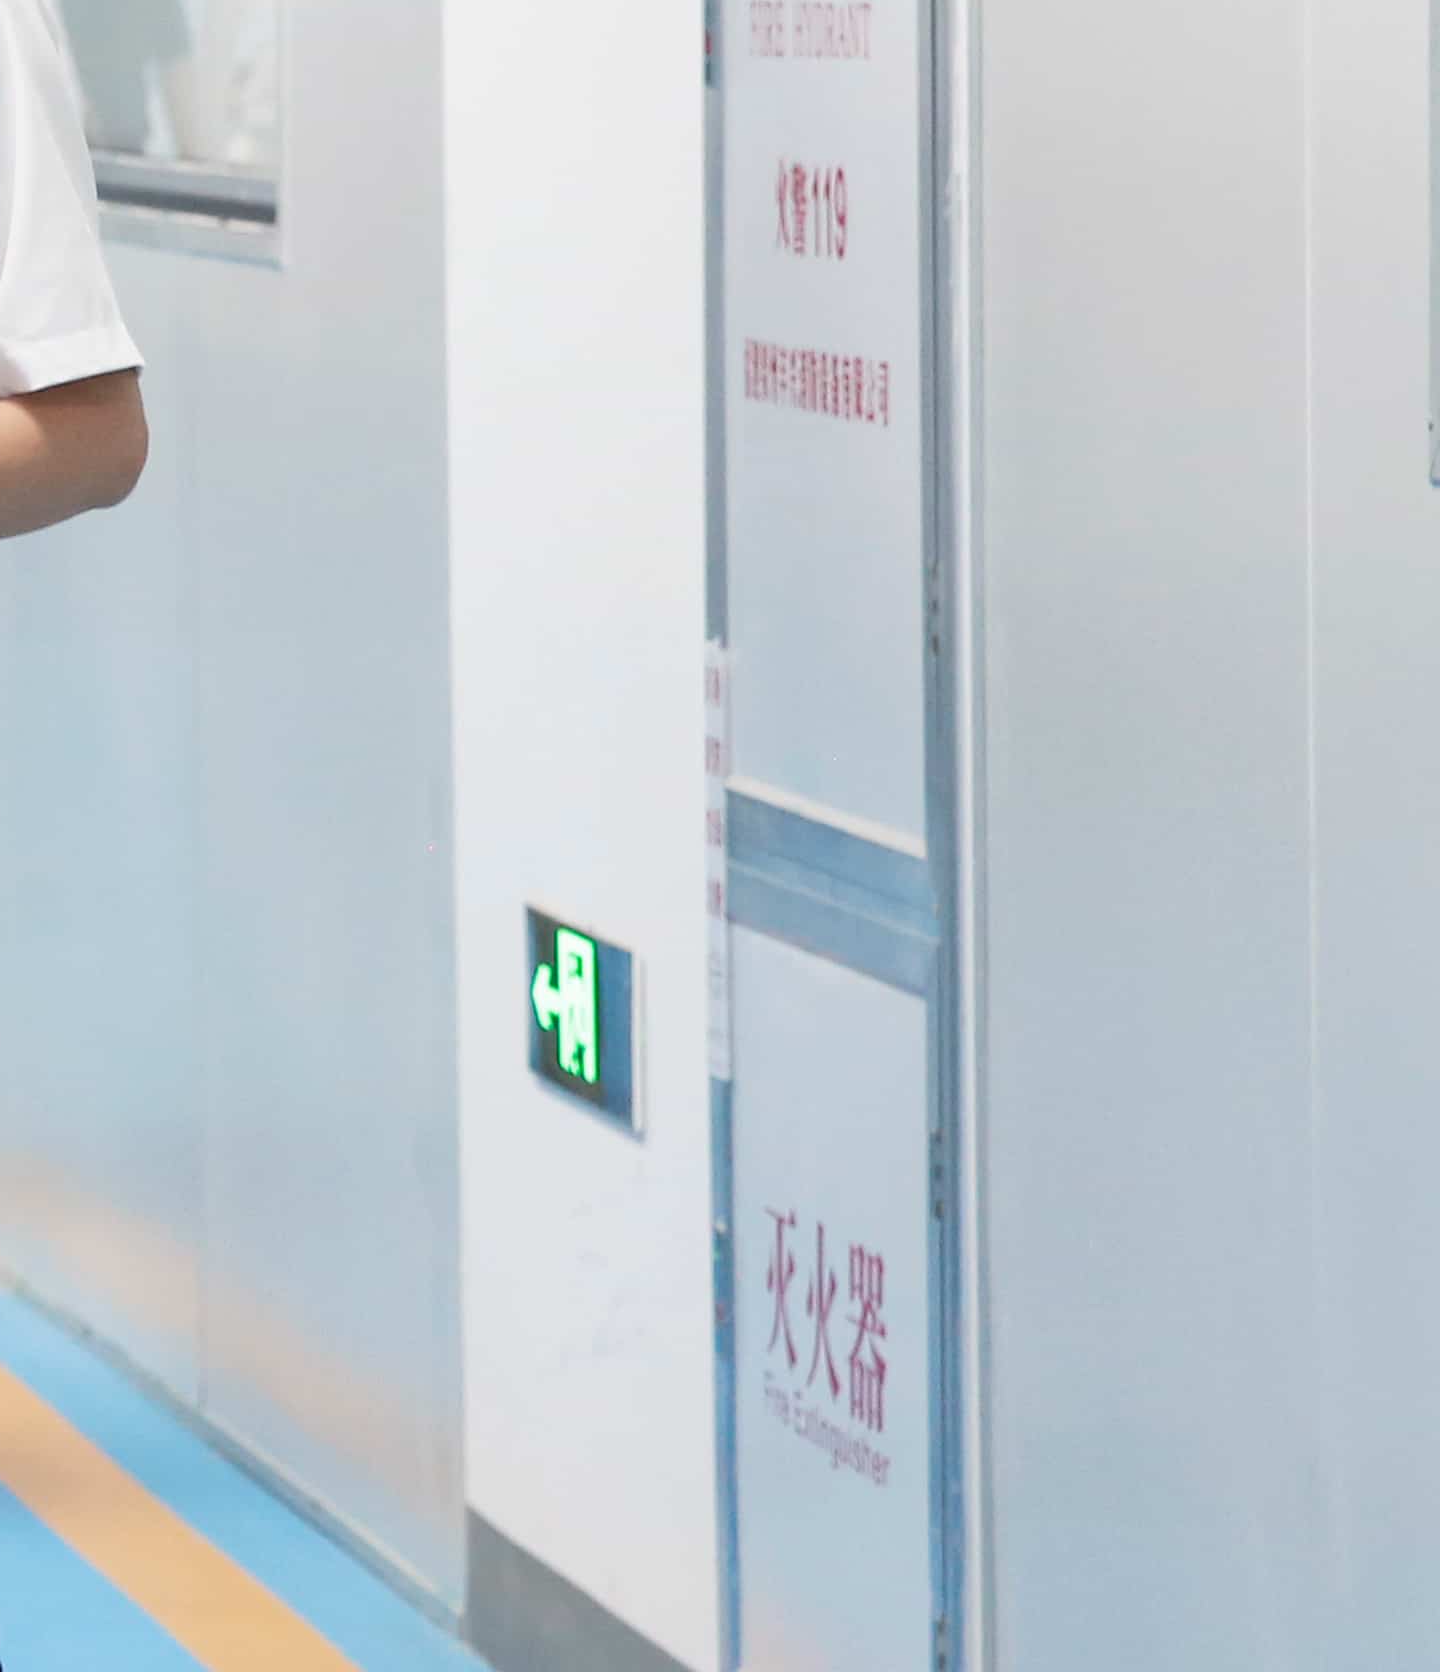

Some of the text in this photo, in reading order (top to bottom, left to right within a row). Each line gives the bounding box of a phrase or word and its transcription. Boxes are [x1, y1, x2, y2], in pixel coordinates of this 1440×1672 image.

[773, 157, 849, 261] 火警119
[764, 1205, 887, 1434] 灭火器
